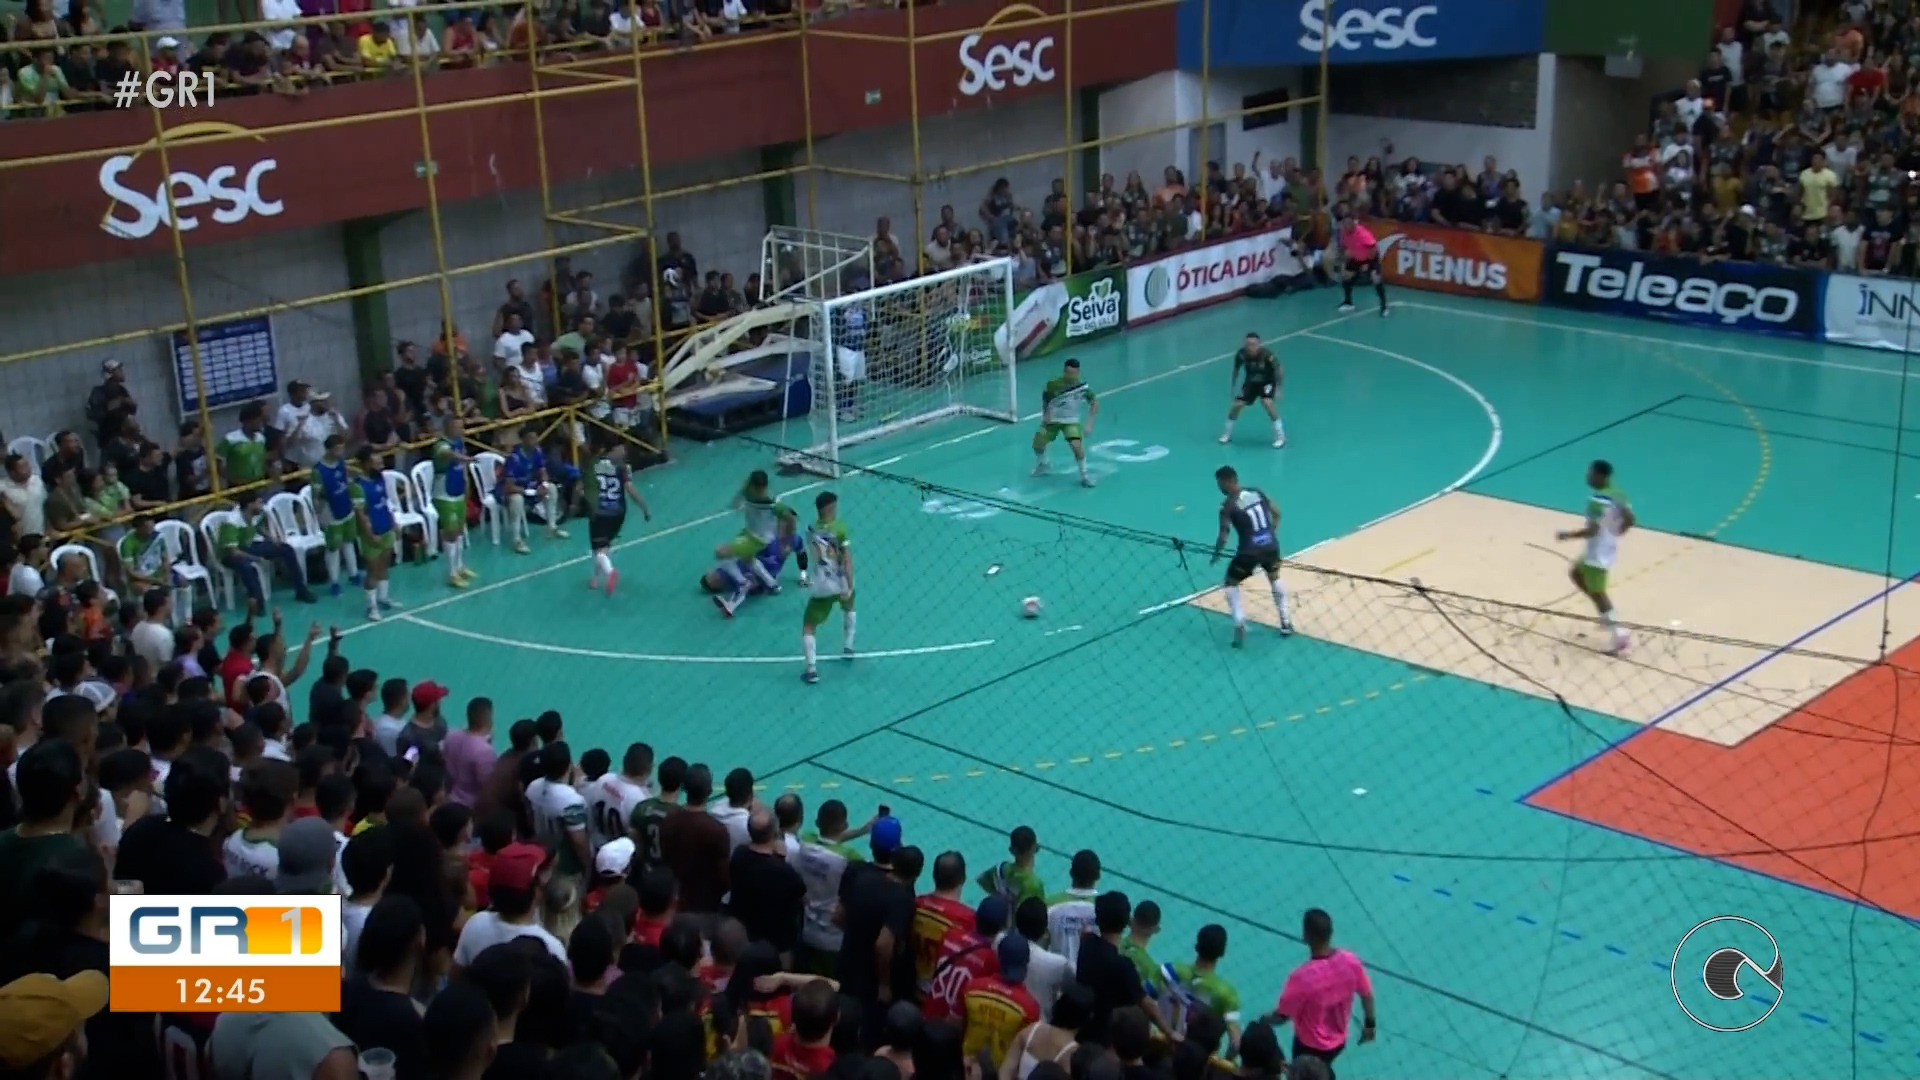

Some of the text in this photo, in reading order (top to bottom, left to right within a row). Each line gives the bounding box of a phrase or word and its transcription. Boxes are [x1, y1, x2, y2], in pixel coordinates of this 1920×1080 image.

[1298, 0, 1438, 52] Sesc
[958, 34, 1055, 95] Sesc
[99, 155, 284, 239] Sesc
[1176, 248, 1276, 291] ÓTICA DIAS
[1397, 250, 1507, 290] PLENUS
[1556, 252, 1798, 324] Teleaço
[1071, 296, 1117, 324] Seiva
[1246, 503, 1268, 532] 11
